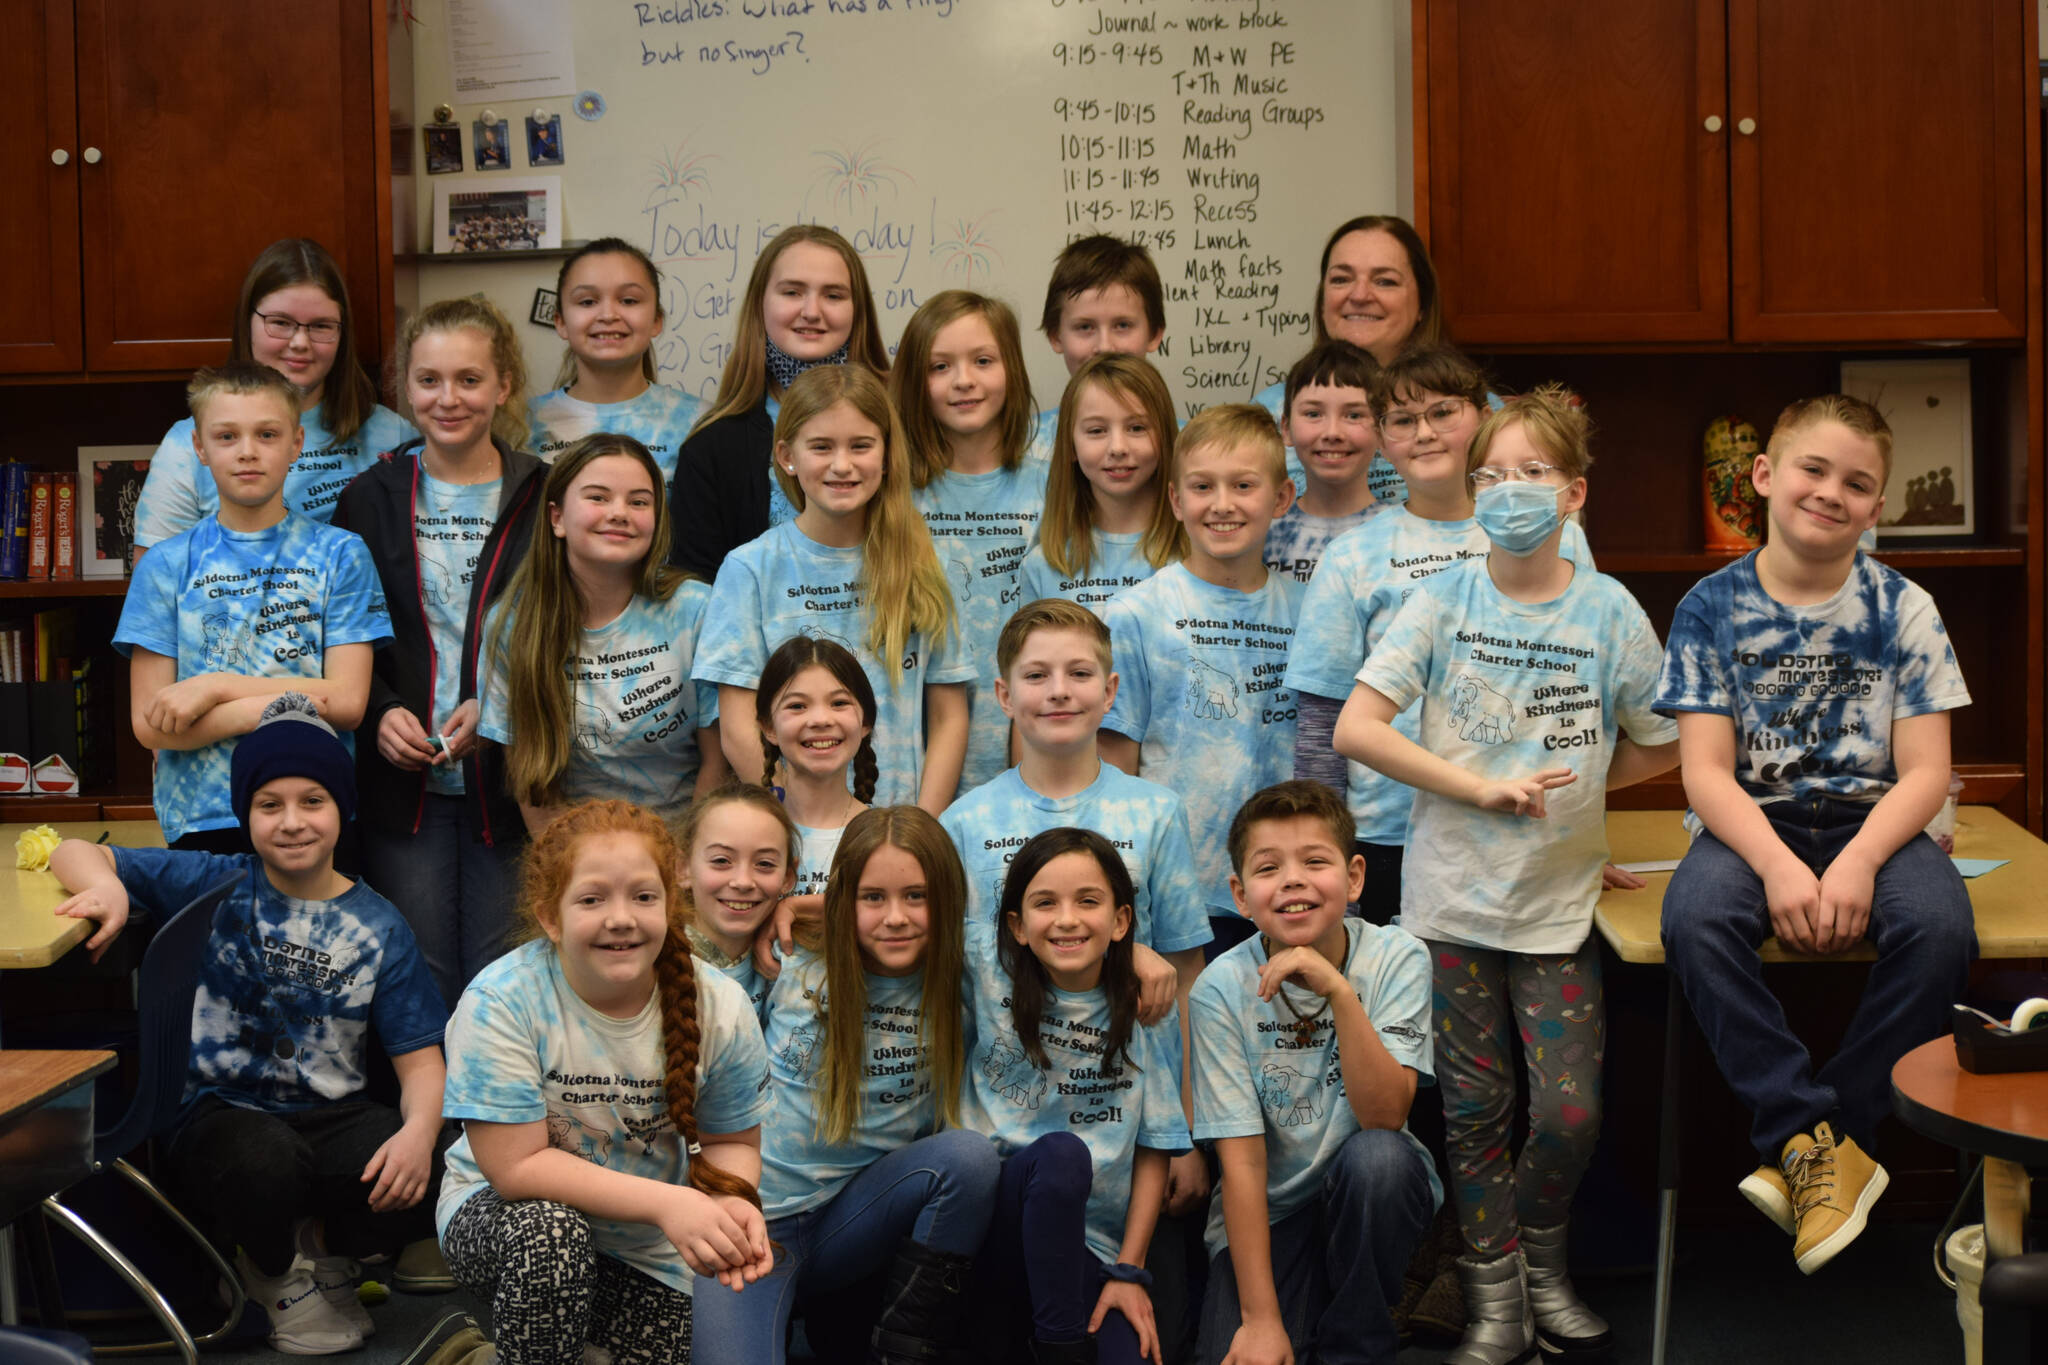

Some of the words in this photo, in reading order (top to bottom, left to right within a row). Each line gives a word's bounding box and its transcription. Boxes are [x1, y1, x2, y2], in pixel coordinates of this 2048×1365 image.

[1088, 8, 1156, 35] Journal
[1186, 14, 1229, 32] work
[1239, 11, 1289, 30] block
[641, 40, 685, 66] but
[1270, 42, 1296, 67] PE
[1233, 73, 1288, 95] Music
[1183, 99, 1252, 140] Reading
[1262, 98, 1324, 131] Groups
[1182, 135, 1236, 160] Math
[1186, 167, 1260, 202] Writing
[1194, 193, 1257, 224] Recess
[642, 198, 740, 283] Today
[1194, 228, 1251, 250] Lunch
[1185, 258, 1226, 284] Math
[1240, 253, 1282, 278] facts
[694, 283, 735, 320] Get
[1164, 283, 1198, 301] lent
[1214, 277, 1279, 308] Reading
[1256, 306, 1311, 336] Typing
[1190, 334, 1250, 371] Library
[297, 461, 343, 472] School
[965, 511, 1039, 522] Montessori
[415, 528, 458, 541] harter
[930, 526, 974, 537] harter
[976, 526, 1023, 537] School
[1390, 553, 1453, 569] Soldotna
[208, 585, 258, 599] Charter
[1059, 577, 1118, 592] Soldotna
[260, 598, 310, 618] Where
[804, 599, 852, 611] Charter
[1076, 592, 1114, 603] Char
[255, 612, 322, 636] Kindness
[1232, 619, 1295, 636] Montesso
[597, 640, 670, 666] Montessori
[1245, 637, 1288, 651] School
[1516, 638, 1595, 659] Montessori
[610, 660, 655, 680] School
[1470, 649, 1524, 668] Charter
[1526, 657, 1577, 674] School
[622, 675, 672, 706] Where
[1533, 683, 1589, 701] Where
[1525, 697, 1600, 719] Kindness
[643, 707, 688, 744] Cool!
[1543, 728, 1599, 752] Cool!
[870, 1019, 919, 1036] School
[561, 1092, 619, 1105] Charter
[1069, 1105, 1123, 1125] Cool!
